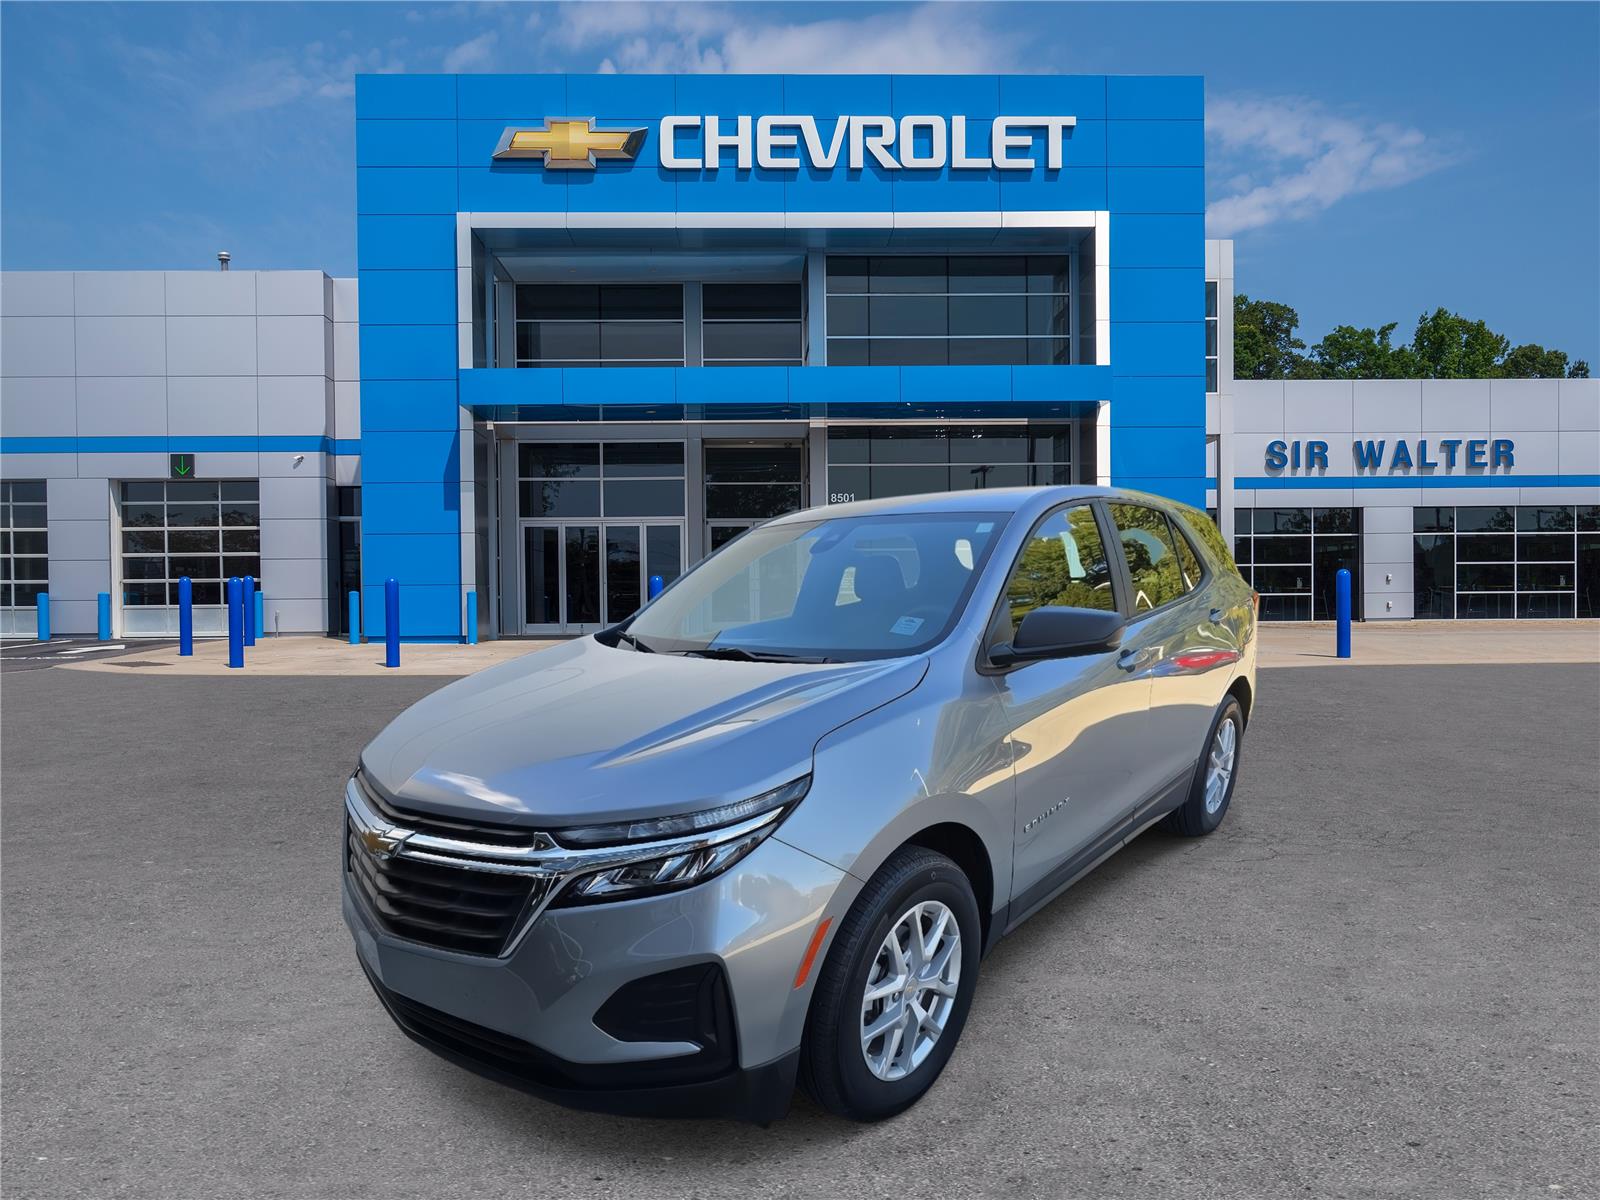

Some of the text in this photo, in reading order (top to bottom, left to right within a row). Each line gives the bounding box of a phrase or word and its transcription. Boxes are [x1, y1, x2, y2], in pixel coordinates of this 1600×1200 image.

[659, 115, 1077, 169] CHEVROLET
[1266, 439, 1515, 469] SIR WALTER
[830, 493, 856, 503] 8501
